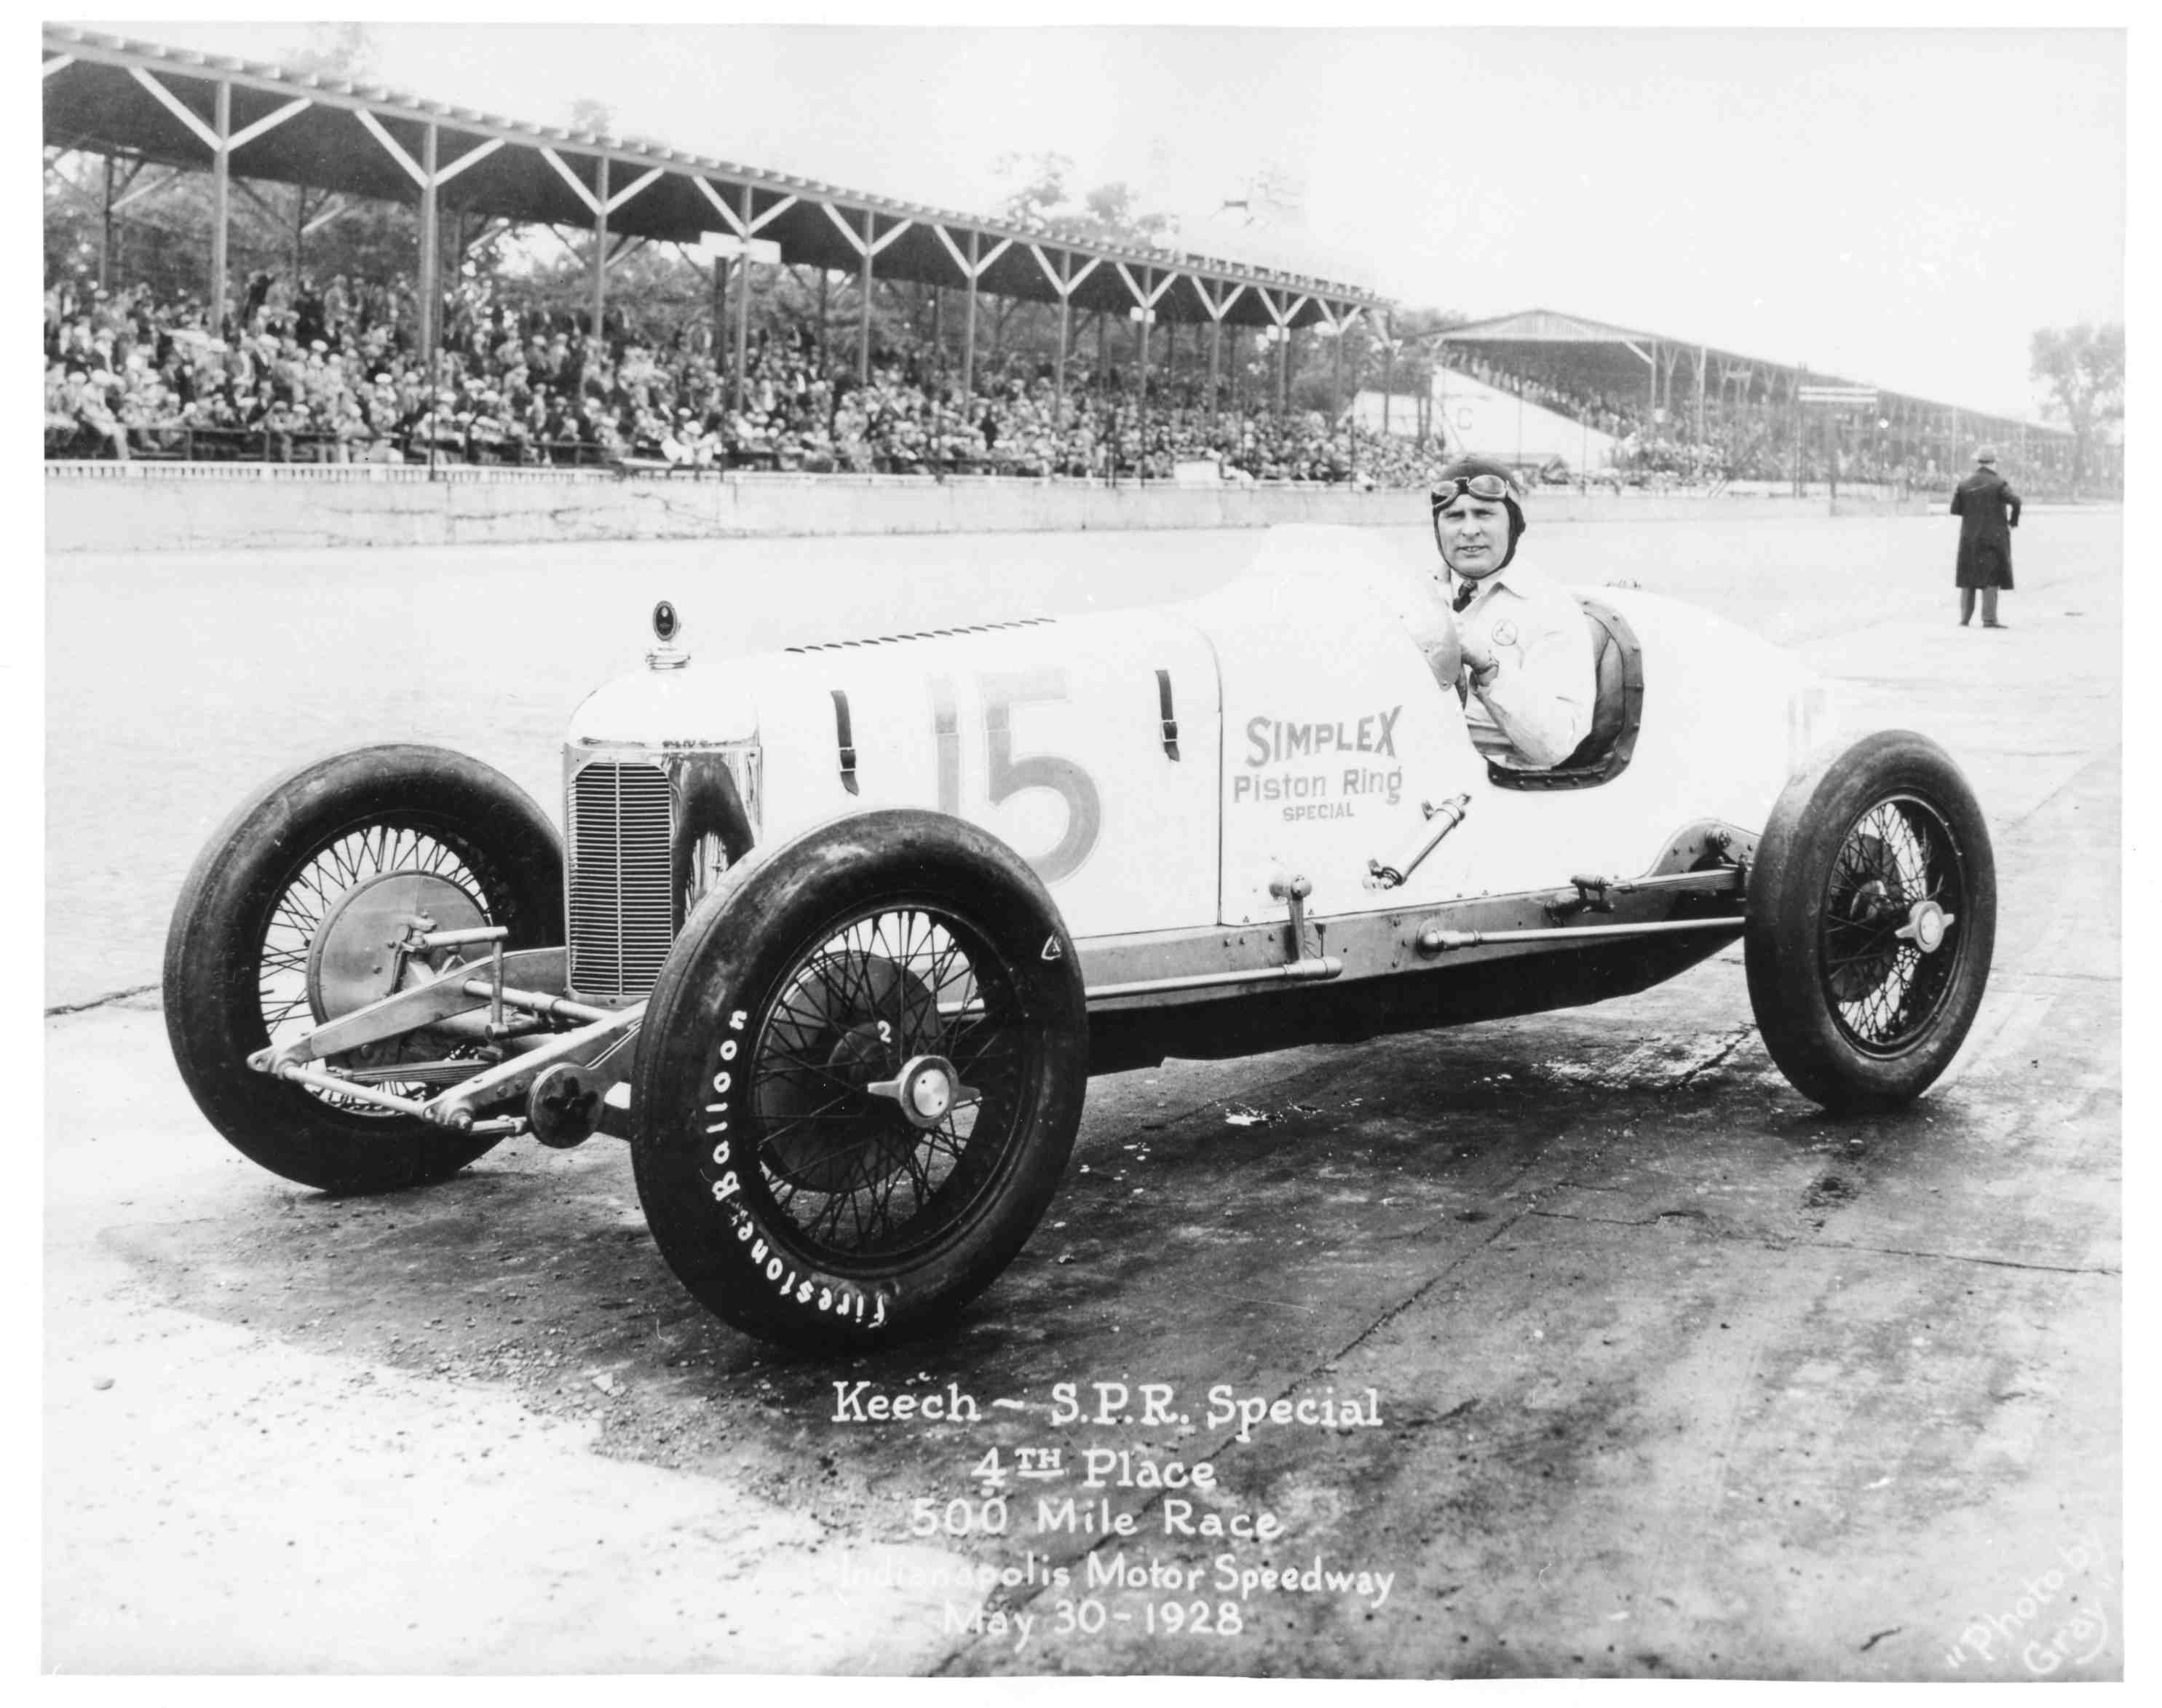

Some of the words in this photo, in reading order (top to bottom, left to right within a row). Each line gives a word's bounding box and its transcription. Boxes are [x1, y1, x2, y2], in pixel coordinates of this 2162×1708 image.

[1246, 704, 1403, 768] SIMPLEX
[924, 668, 1101, 885] 15
[1233, 772, 1326, 804] Piston
[1343, 766, 1402, 805] Ring
[1282, 802, 1355, 822] SPECIAL
[877, 1020, 892, 1043] 2
[705, 1010, 748, 1202] Balloon
